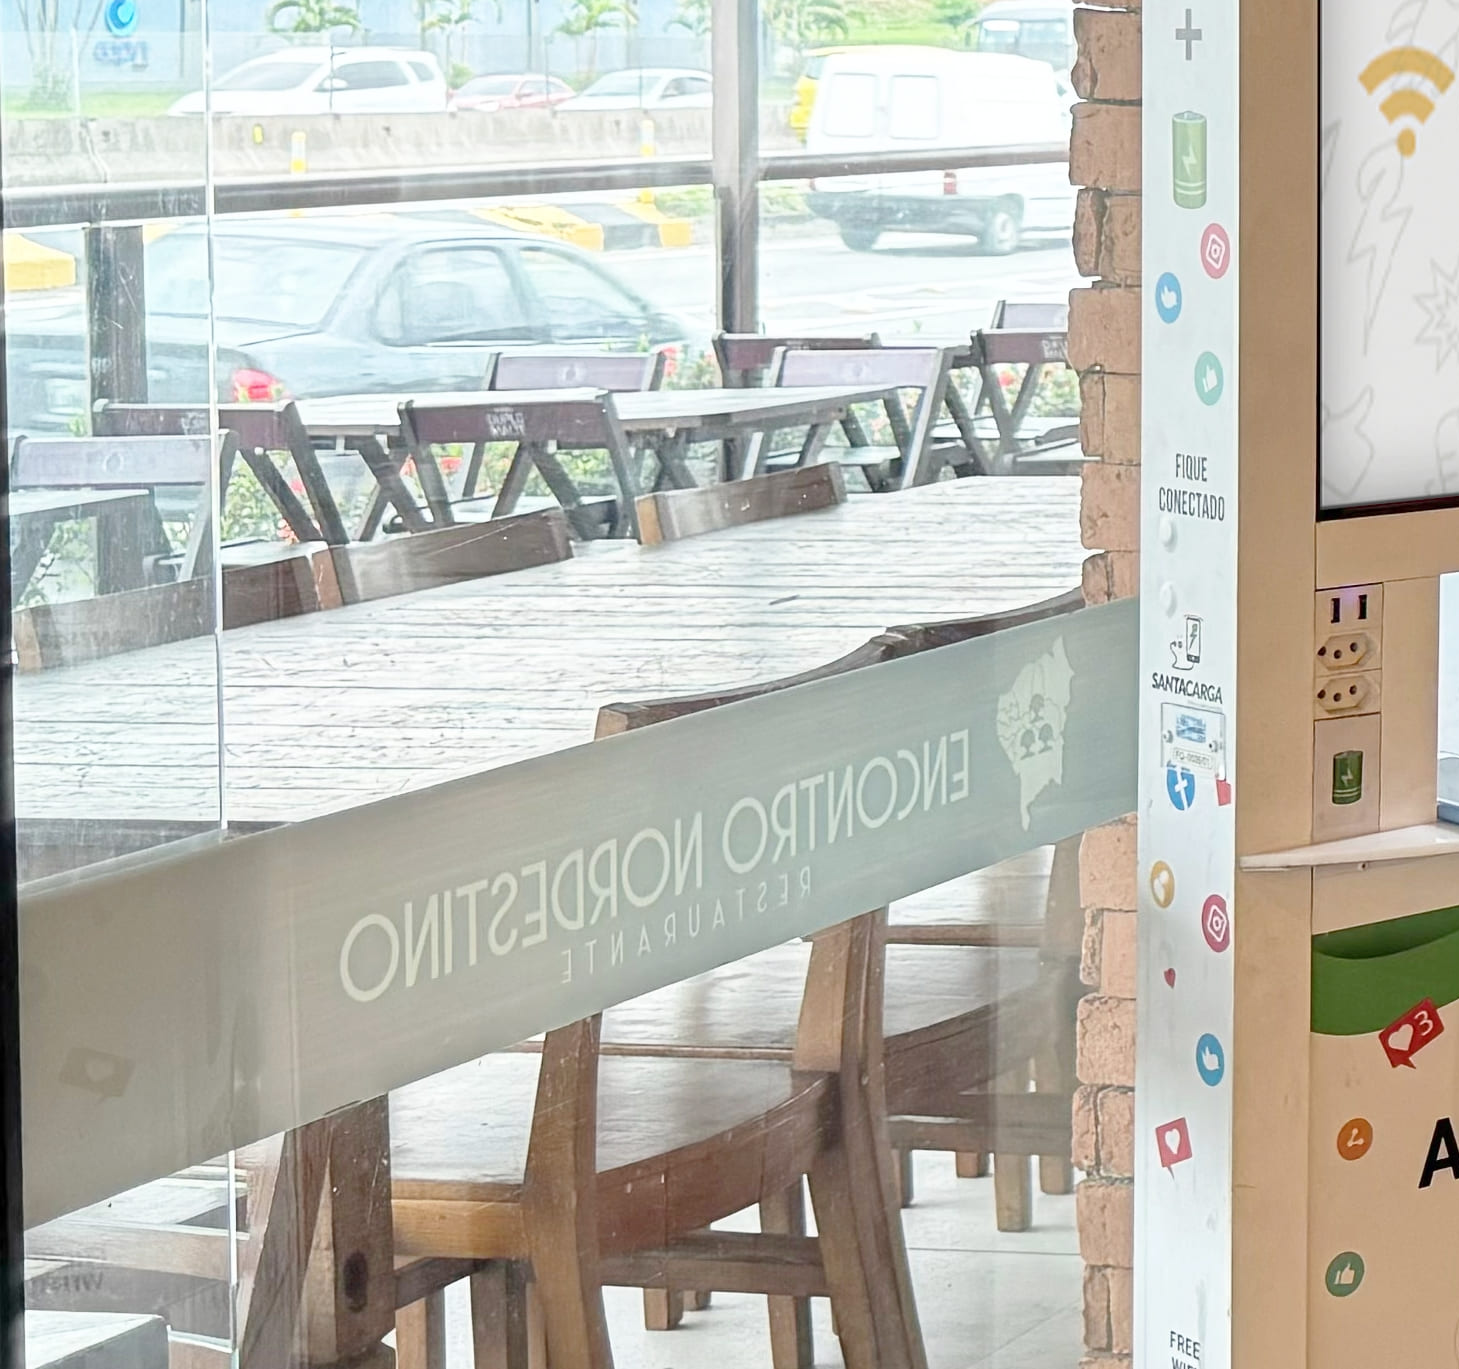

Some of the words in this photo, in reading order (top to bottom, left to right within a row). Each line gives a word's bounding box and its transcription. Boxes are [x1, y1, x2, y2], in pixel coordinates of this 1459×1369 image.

[1175, 453, 1208, 482] FIQUE
[1159, 486, 1225, 522] CONECTADO
[1152, 672, 1224, 705] SANTACARGA
[1170, 1330, 1201, 1361] FREE
